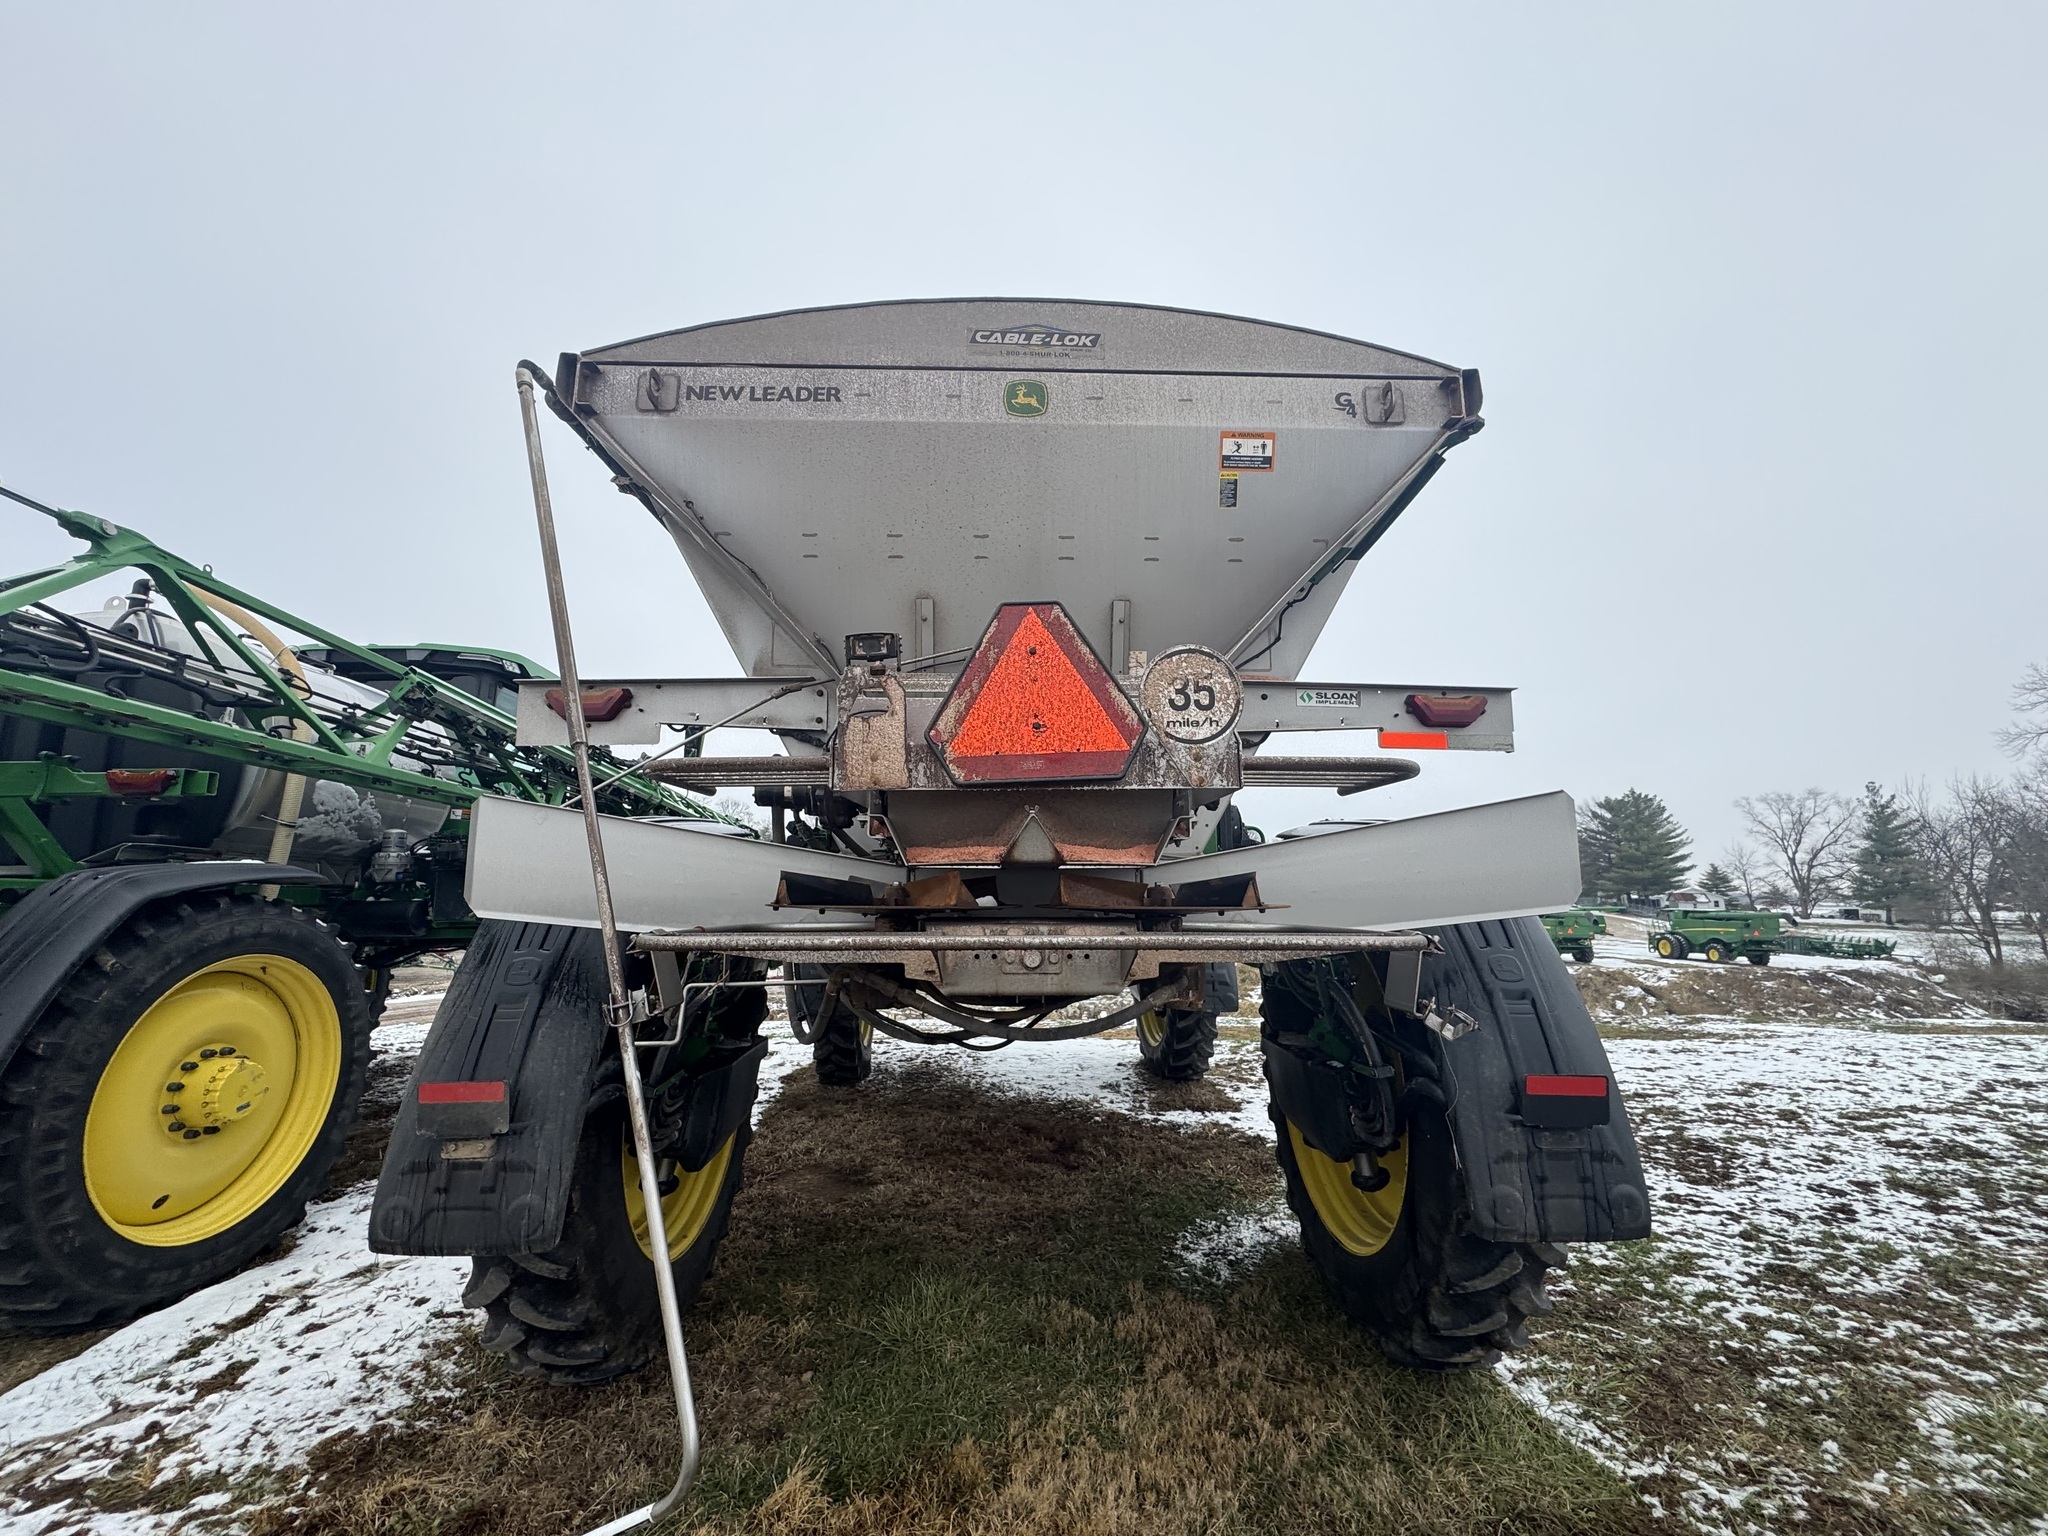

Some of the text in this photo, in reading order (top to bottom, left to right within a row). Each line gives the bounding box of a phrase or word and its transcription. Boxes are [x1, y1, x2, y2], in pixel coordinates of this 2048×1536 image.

[975, 331, 1095, 347] CABLE-LOK
[685, 385, 841, 403] NEW LEADER
[1168, 674, 1216, 711] 35
[1315, 692, 1358, 700] SLOAN
[1166, 717, 1219, 727] mile/h
